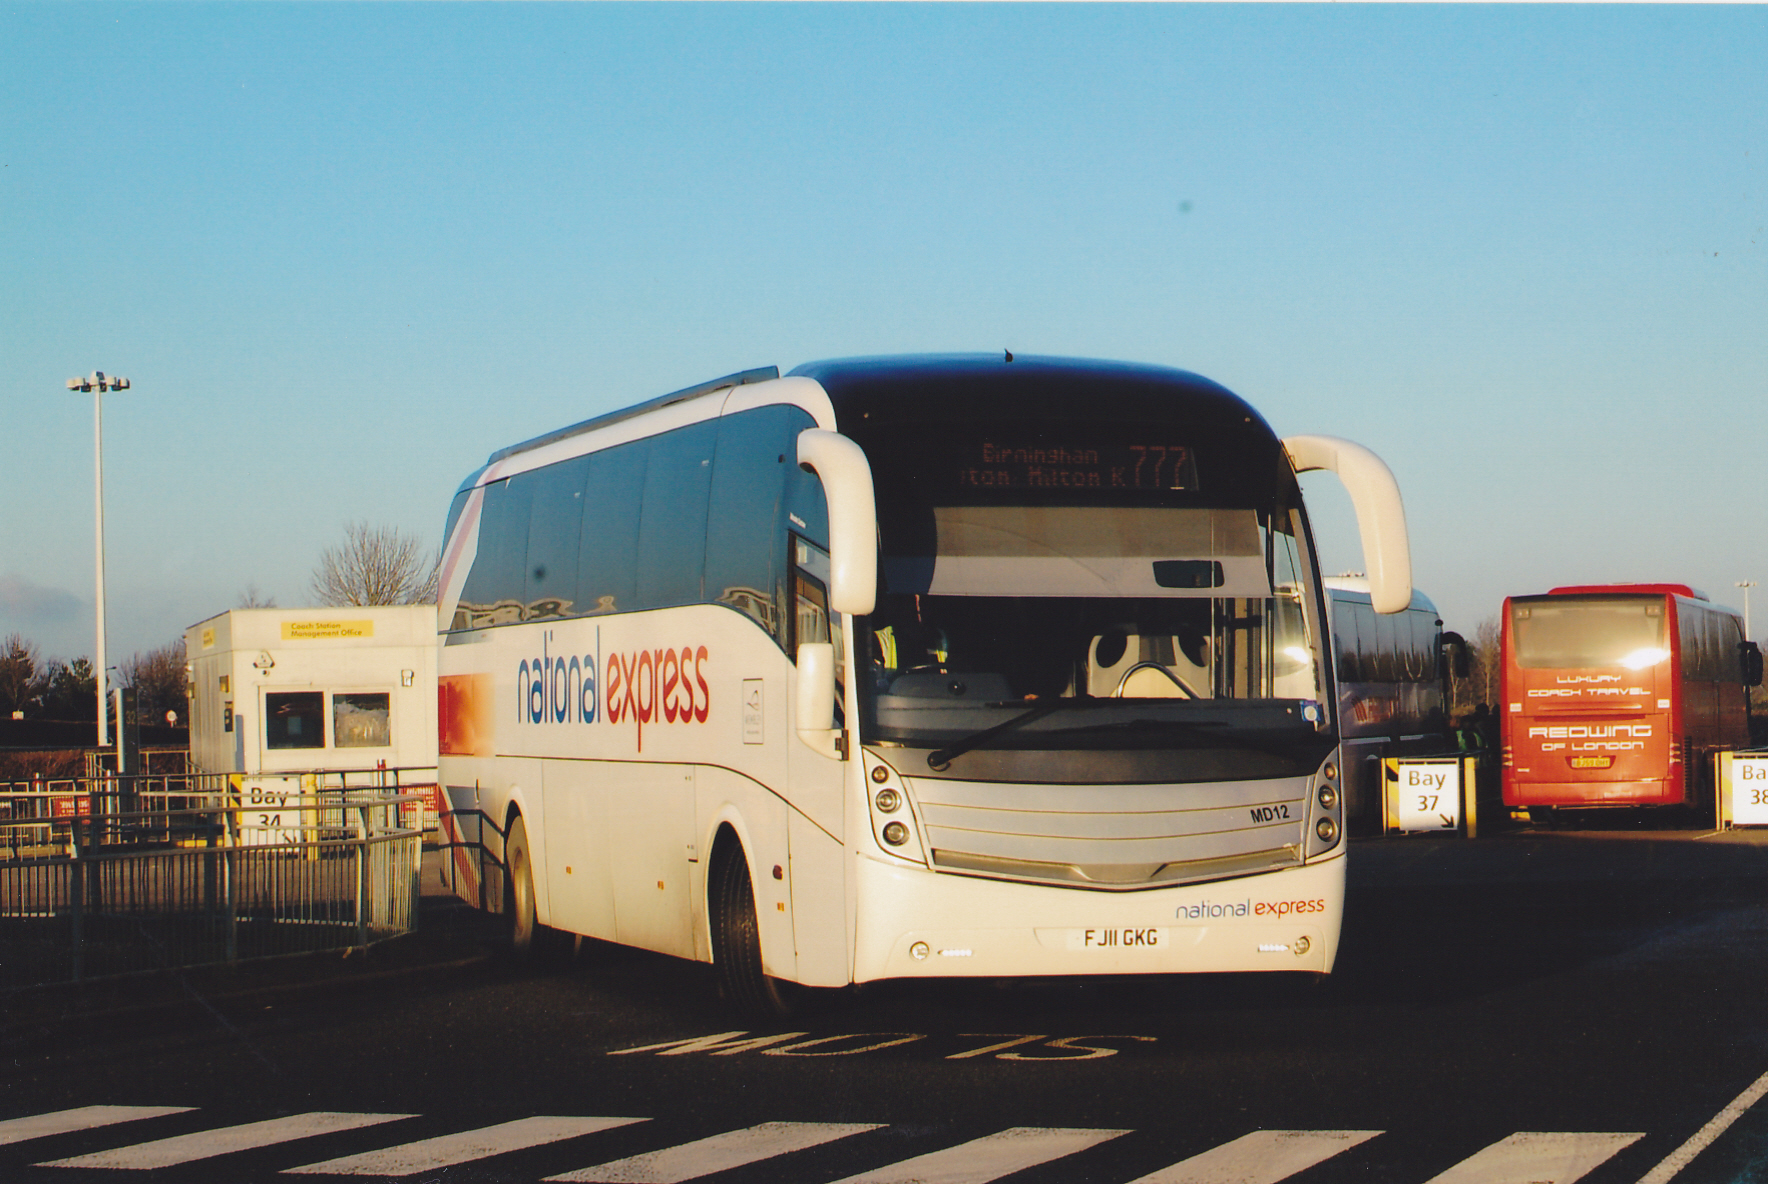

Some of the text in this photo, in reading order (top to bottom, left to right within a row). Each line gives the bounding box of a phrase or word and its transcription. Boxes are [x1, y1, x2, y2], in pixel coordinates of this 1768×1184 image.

[1129, 445, 1186, 488] 777
[291, 630, 339, 638] Management
[1556, 675, 1622, 684] LUXURY
[518, 625, 709, 753] national express
[1528, 687, 1651, 697] COACH TRAVEL
[1528, 725, 1652, 738] REDWING
[1541, 741, 1644, 751] OF LONDON
[1408, 770, 1446, 790] Bay
[251, 787, 289, 808] Bay
[1418, 795, 1439, 811] 37
[1250, 805, 1290, 824] MD12
[1175, 898, 1325, 919] national express
[1084, 928, 1157, 946] FJ11 GKG
